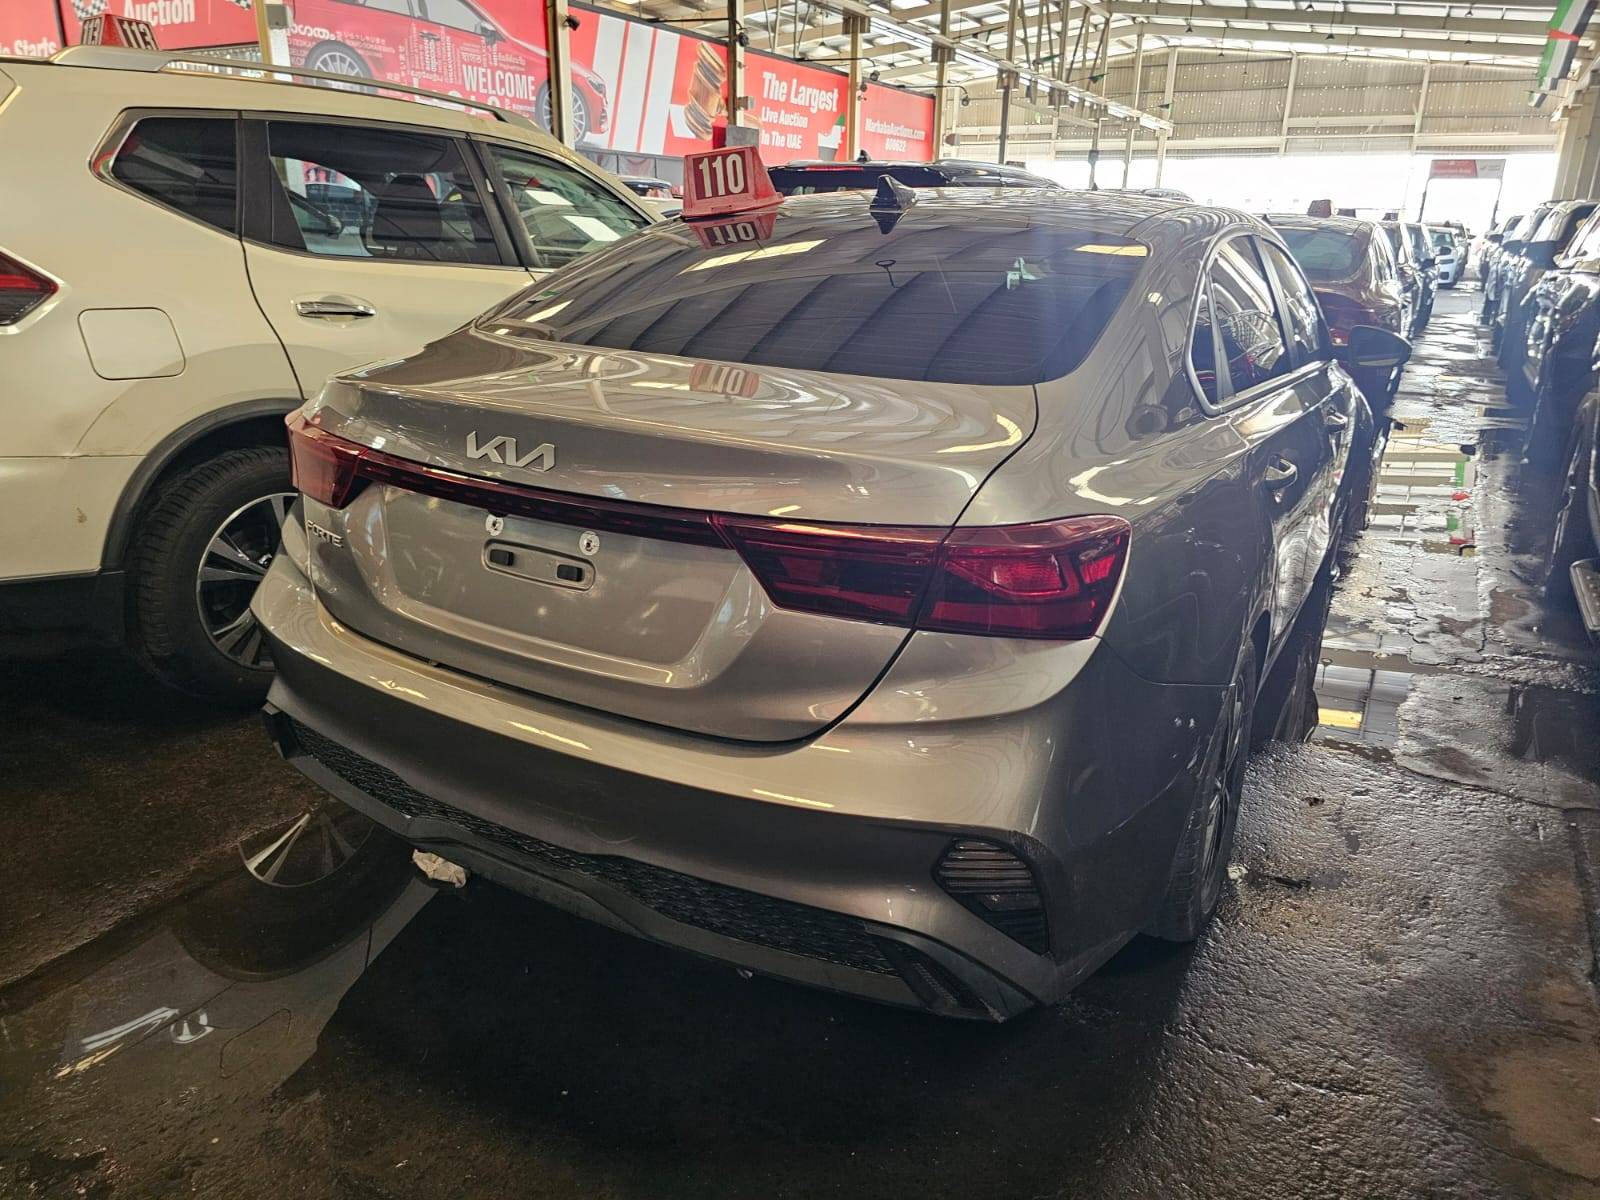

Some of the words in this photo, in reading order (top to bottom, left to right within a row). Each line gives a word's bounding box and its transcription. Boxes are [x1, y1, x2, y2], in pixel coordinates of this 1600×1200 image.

[123, 0, 195, 26] Auction
[121, 20, 159, 50] 113
[462, 64, 537, 101] WELCOME
[762, 71, 788, 102] The
[790, 78, 839, 114] Largest
[761, 106, 779, 123] Live
[779, 109, 808, 128] Auction
[760, 129, 770, 146] In
[771, 130, 786, 148] The
[698, 153, 745, 198] 110
[466, 430, 556, 472] KIA
